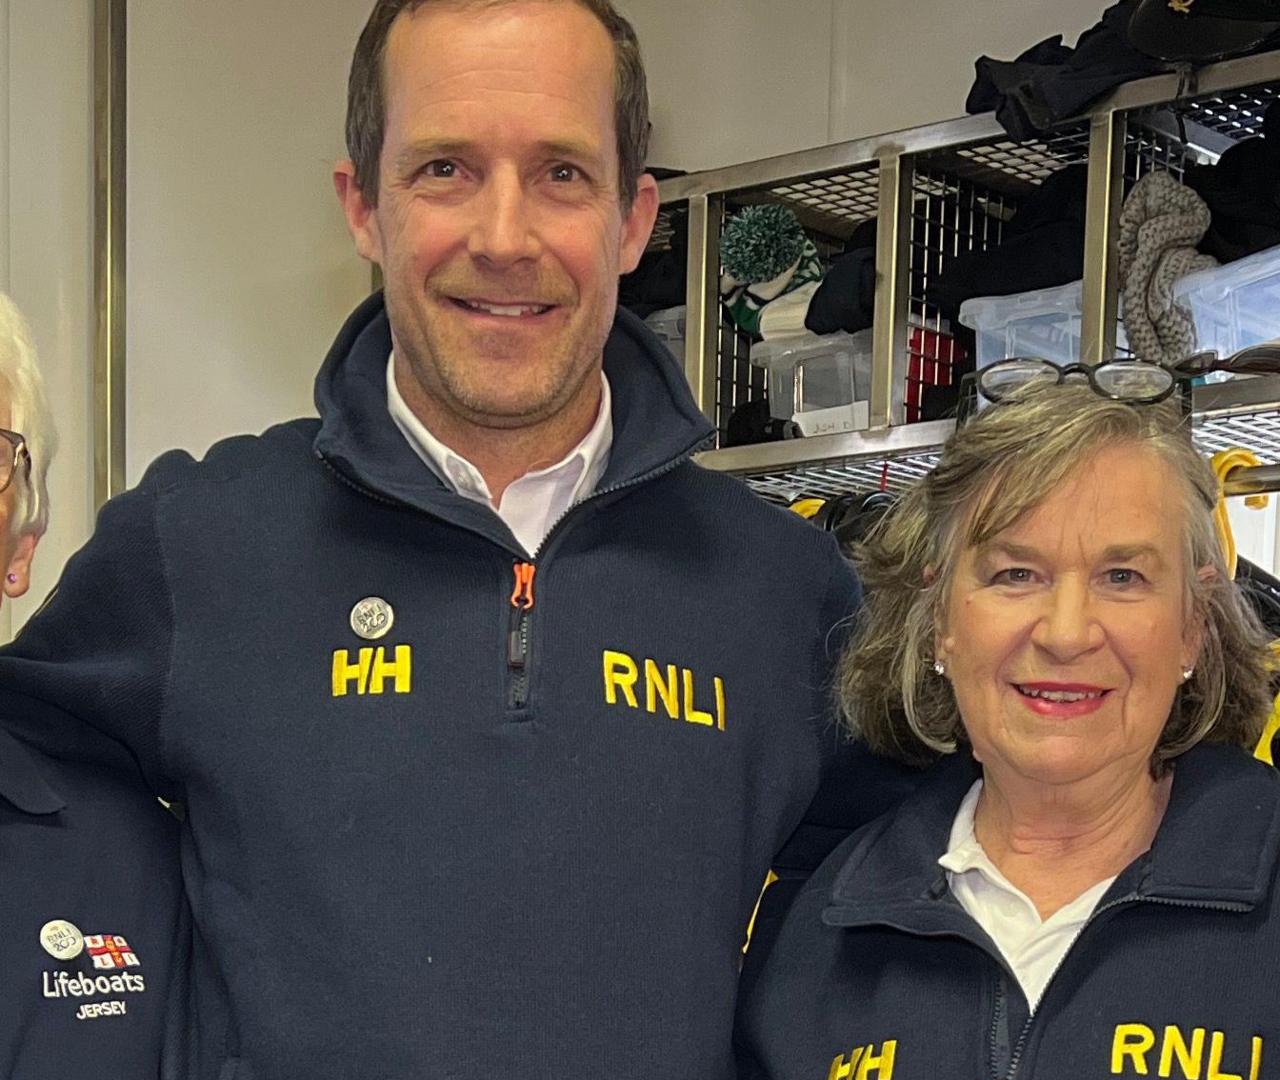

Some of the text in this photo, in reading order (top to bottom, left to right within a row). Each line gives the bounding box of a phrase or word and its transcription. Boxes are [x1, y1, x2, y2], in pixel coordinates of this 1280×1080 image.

[332, 645, 411, 696] HH
[603, 650, 725, 731] RNLI
[43, 971, 145, 998] Lifeboats
[76, 1001, 127, 1020] JERSEY
